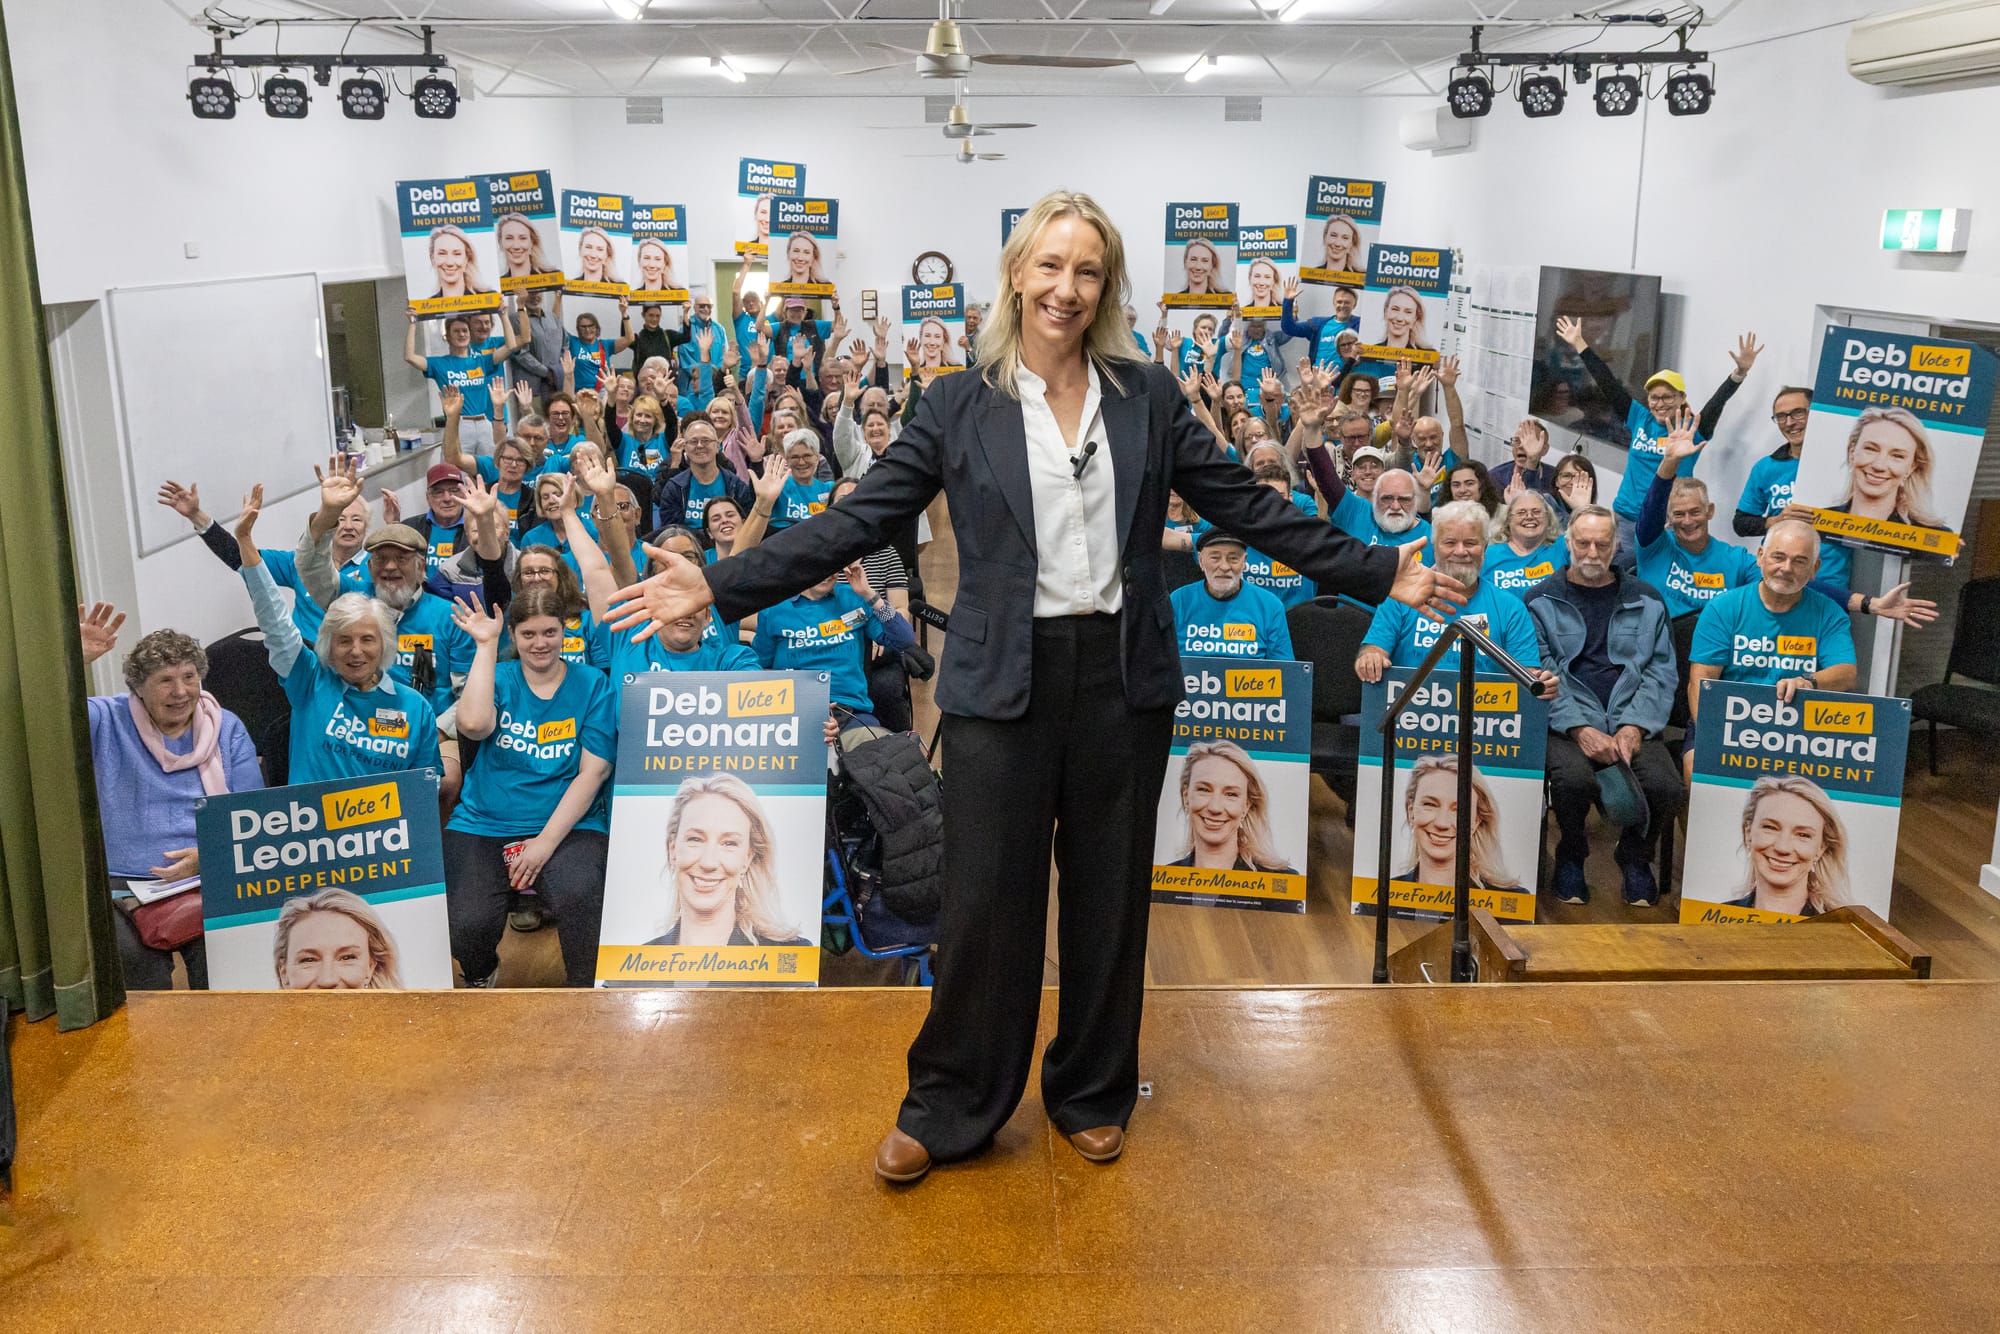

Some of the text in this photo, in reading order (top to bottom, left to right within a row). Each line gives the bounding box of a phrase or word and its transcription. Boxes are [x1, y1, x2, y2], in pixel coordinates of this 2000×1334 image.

[747, 163, 772, 175] Deb
[490, 179, 509, 192] eb
[747, 173, 797, 188] Leonard
[1318, 181, 1346, 195] Deb
[1350, 185, 1366, 193] Vote
[409, 186, 445, 202] Deb
[450, 187, 467, 197] Vote
[491, 189, 543, 204] onard
[746, 185, 796, 195] INDEPENDENT
[410, 199, 481, 216] Leonard
[492, 203, 544, 213] DEPENDENT
[570, 195, 598, 208] Deb
[779, 201, 804, 213] Deb
[1317, 193, 1374, 209] Leonard
[570, 206, 624, 221] Leonard
[632, 209, 652, 220] eb
[779, 211, 829, 224] Leonard
[1175, 207, 1202, 218] Deb
[1316, 205, 1373, 217] INDEPENDENT
[412, 215, 481, 226] INDEPENDENT
[569, 218, 623, 229] INDEPENDENT
[632, 219, 678, 230] eonard
[778, 223, 829, 231] INDEPENDENT
[1175, 218, 1229, 230] Leonard
[1239, 230, 1264, 240] Deb
[1239, 239, 1288, 250] Leonard
[1379, 250, 1409, 265] Deb
[1414, 255, 1431, 264] Vote
[1377, 263, 1440, 279] Leonard
[501, 277, 548, 290] reForMonash
[1376, 276, 1439, 289] INDEPENDENT
[909, 289, 933, 300] Deb
[420, 297, 482, 310] MoreForMonash
[910, 298, 956, 310] Leonard
[910, 309, 956, 317] INDEPENDENT
[1843, 339, 1965, 368] Deb Vote 1
[1839, 360, 1971, 399] Leonard
[1836, 386, 1966, 416] INDEPENDENT
[1632, 438, 1667, 455] Leona
[688, 499, 704, 510] eb
[1812, 513, 1918, 543] MoreForMonash
[1241, 574, 1302, 588] eonard
[1697, 575, 1714, 585] Vote
[920, 608, 945, 624] DEITY
[1186, 623, 1222, 638] Deb
[1228, 628, 1246, 637] Vote
[1185, 640, 1259, 655] Leonard
[1734, 635, 1813, 651] Deb Vote 1
[1733, 651, 1817, 673] Leonard
[1184, 670, 1276, 695] eb Vote 1
[648, 686, 787, 716] Deb Vote 1
[1473, 690, 1498, 707] ote
[1502, 690, 1511, 704] 1
[1174, 699, 1286, 724] eonard
[1725, 695, 1866, 727] Deb Vote 1
[500, 711, 572, 740] Deb Vote 1
[1386, 705, 1522, 738] eonard
[325, 719, 409, 759] Leonard
[646, 716, 799, 747] Leonard
[1172, 724, 1287, 742] DEPENDENT
[1394, 736, 1521, 758] NDEPEDENT
[1723, 721, 1877, 763] Leonard
[645, 755, 799, 771] INDEPENDENT
[1721, 752, 1876, 783] INDEPENDENT
[230, 792, 391, 841] Deb Vote 1
[233, 819, 410, 874] Leonard
[236, 858, 413, 899] INDEPENDENT
[1152, 870, 1266, 891] MoreForMonash
[1371, 886, 1494, 910] oreForMoash
[619, 952, 769, 974] MoreForMonash
